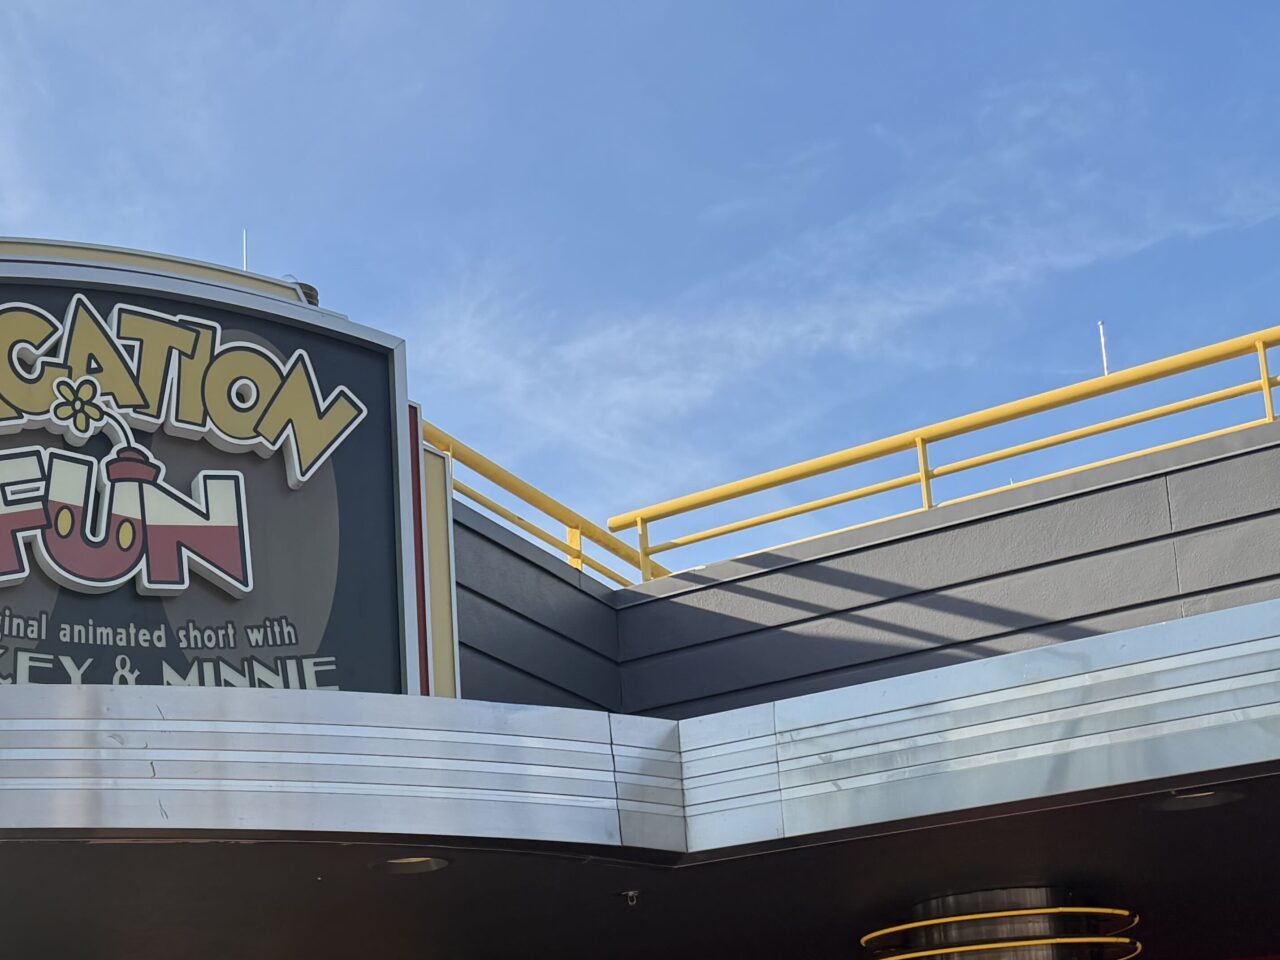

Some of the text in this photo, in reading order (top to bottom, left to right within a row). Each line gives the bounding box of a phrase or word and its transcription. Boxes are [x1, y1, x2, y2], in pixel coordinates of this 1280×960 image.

[59, 618, 167, 648] animated
[178, 622, 236, 648] short
[247, 618, 297, 646] with
[112, 654, 141, 685] &
[162, 656, 339, 691] MINNIE
